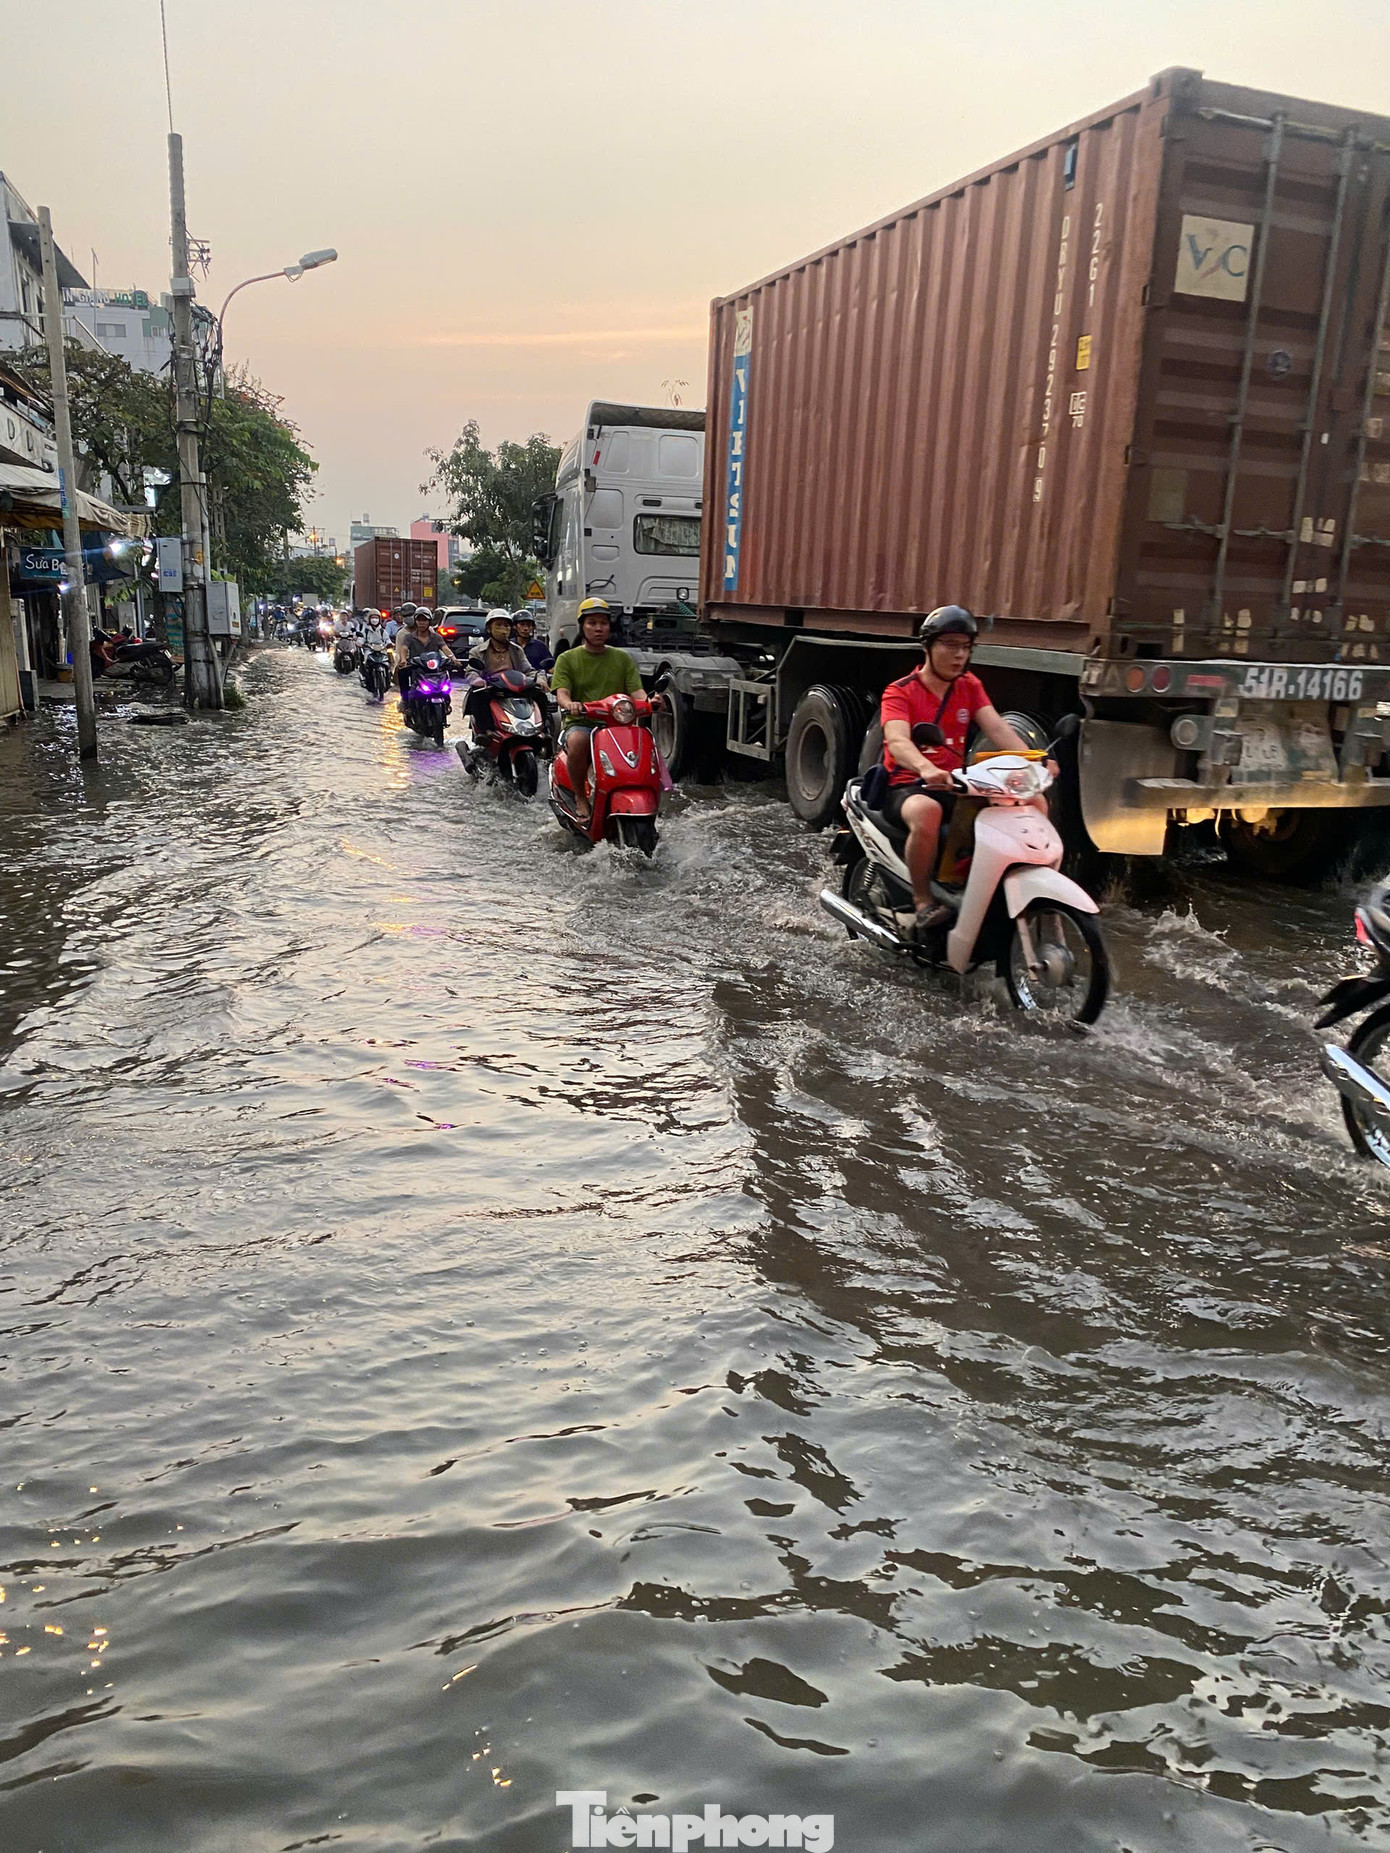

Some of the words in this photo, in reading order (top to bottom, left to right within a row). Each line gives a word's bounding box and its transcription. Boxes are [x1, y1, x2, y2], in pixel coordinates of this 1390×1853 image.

[1054, 216, 1070, 315] DRYU
[1089, 203, 1103, 307] 22G1
[1238, 667, 1363, 700] 51R-14166
